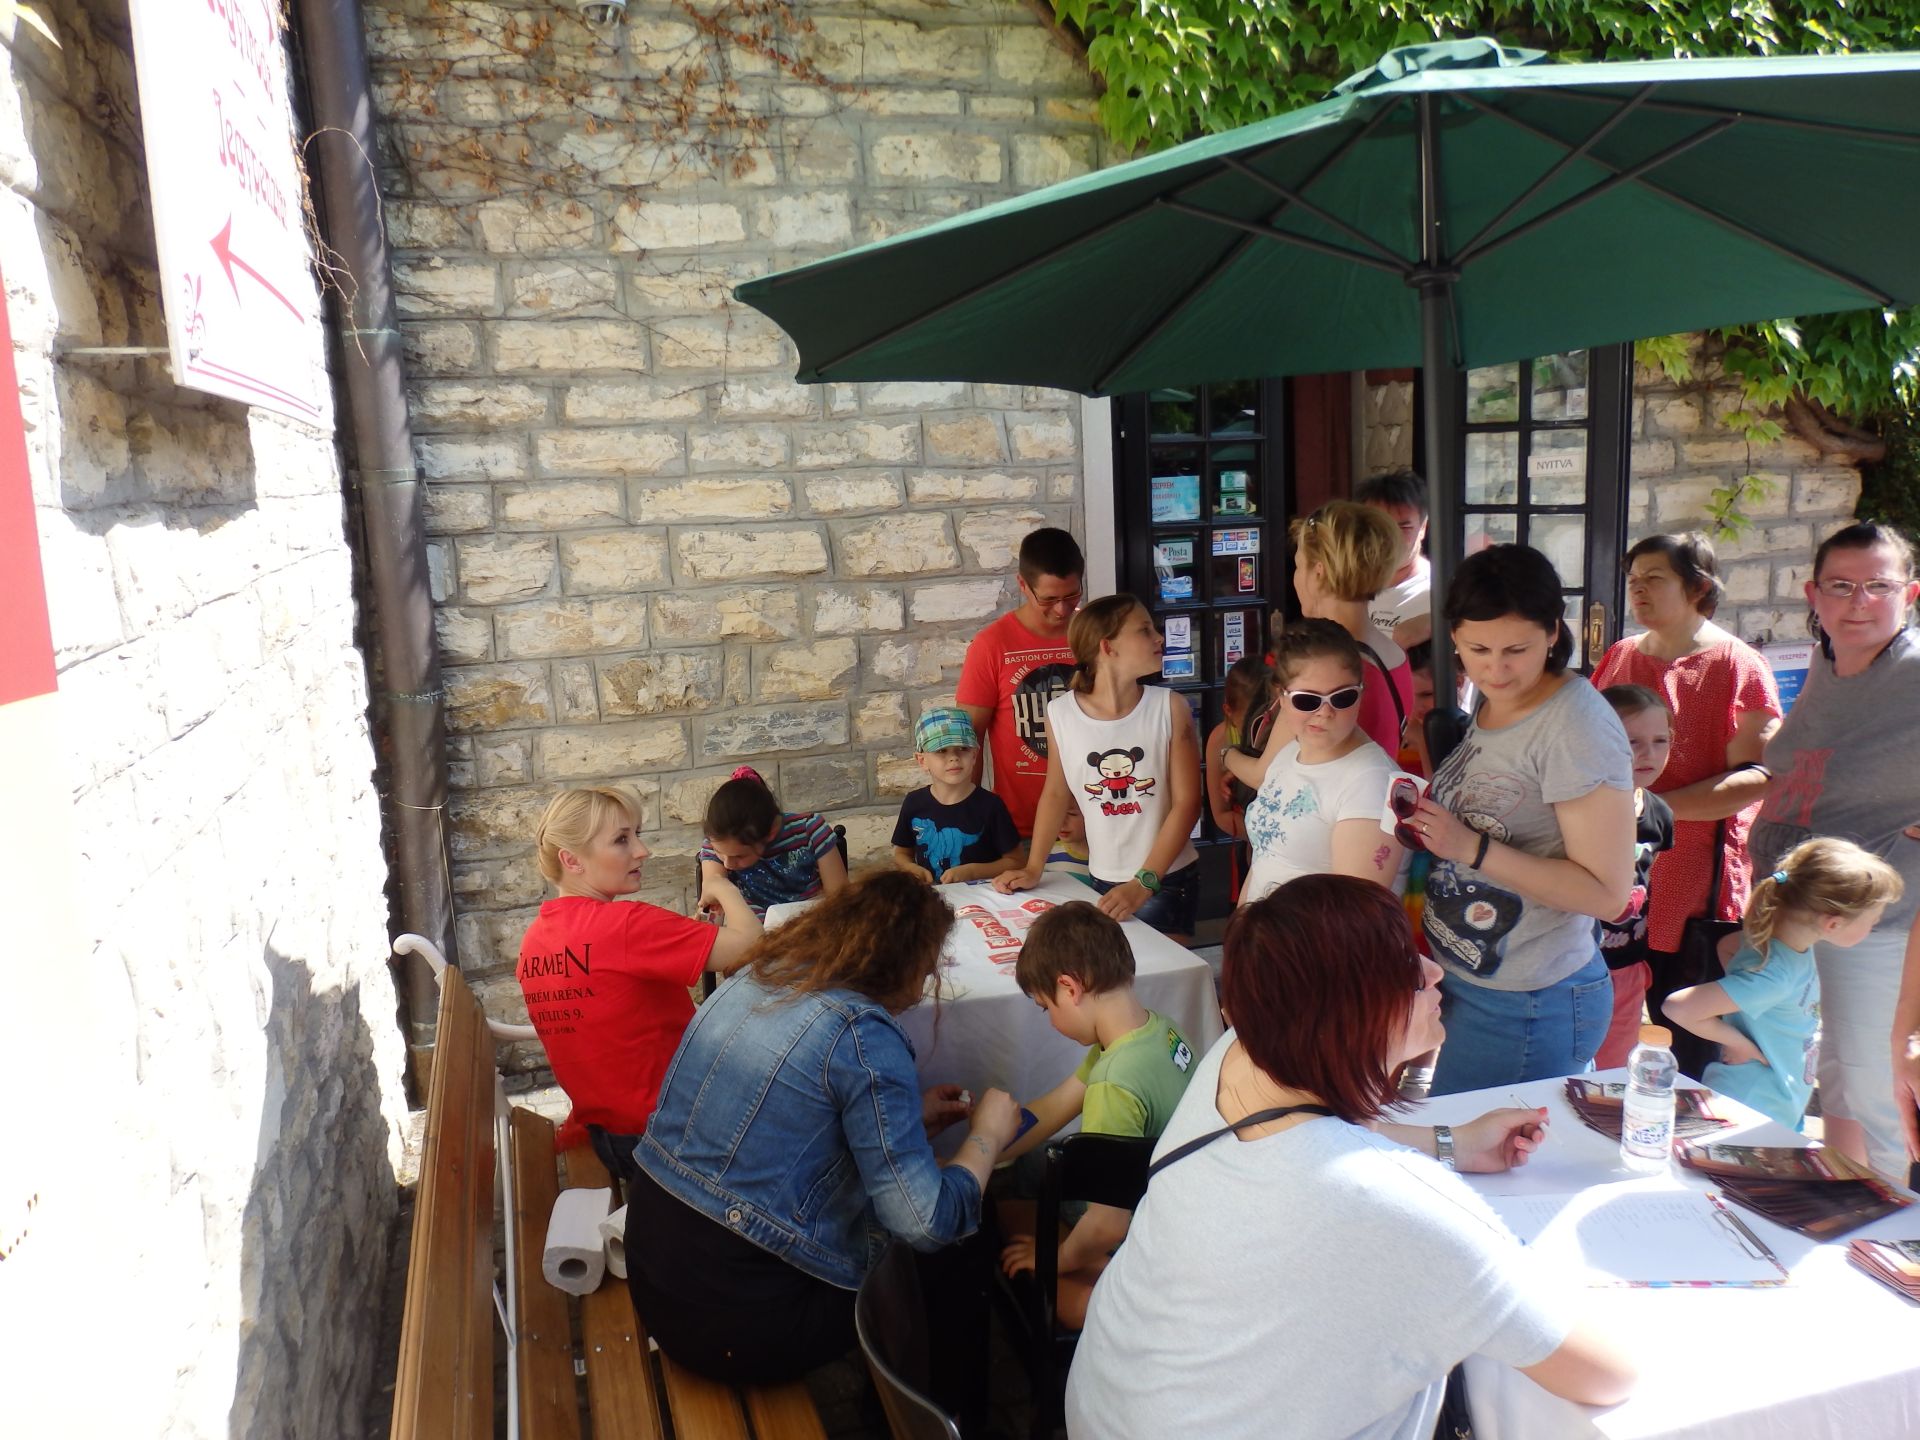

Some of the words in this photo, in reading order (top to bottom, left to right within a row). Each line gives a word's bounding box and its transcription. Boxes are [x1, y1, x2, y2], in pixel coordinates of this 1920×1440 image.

[1536, 459, 1573, 470] NYITVA
[1168, 546, 1188, 557] Posta
[1004, 654, 1040, 665] BASTION
[1010, 664, 1031, 685] WORK
[519, 943, 592, 984] ARMEN
[551, 986, 595, 1002] ARÉNA
[538, 1008, 570, 1025] JÚLIUS
[573, 1008, 584, 1020] 9.
